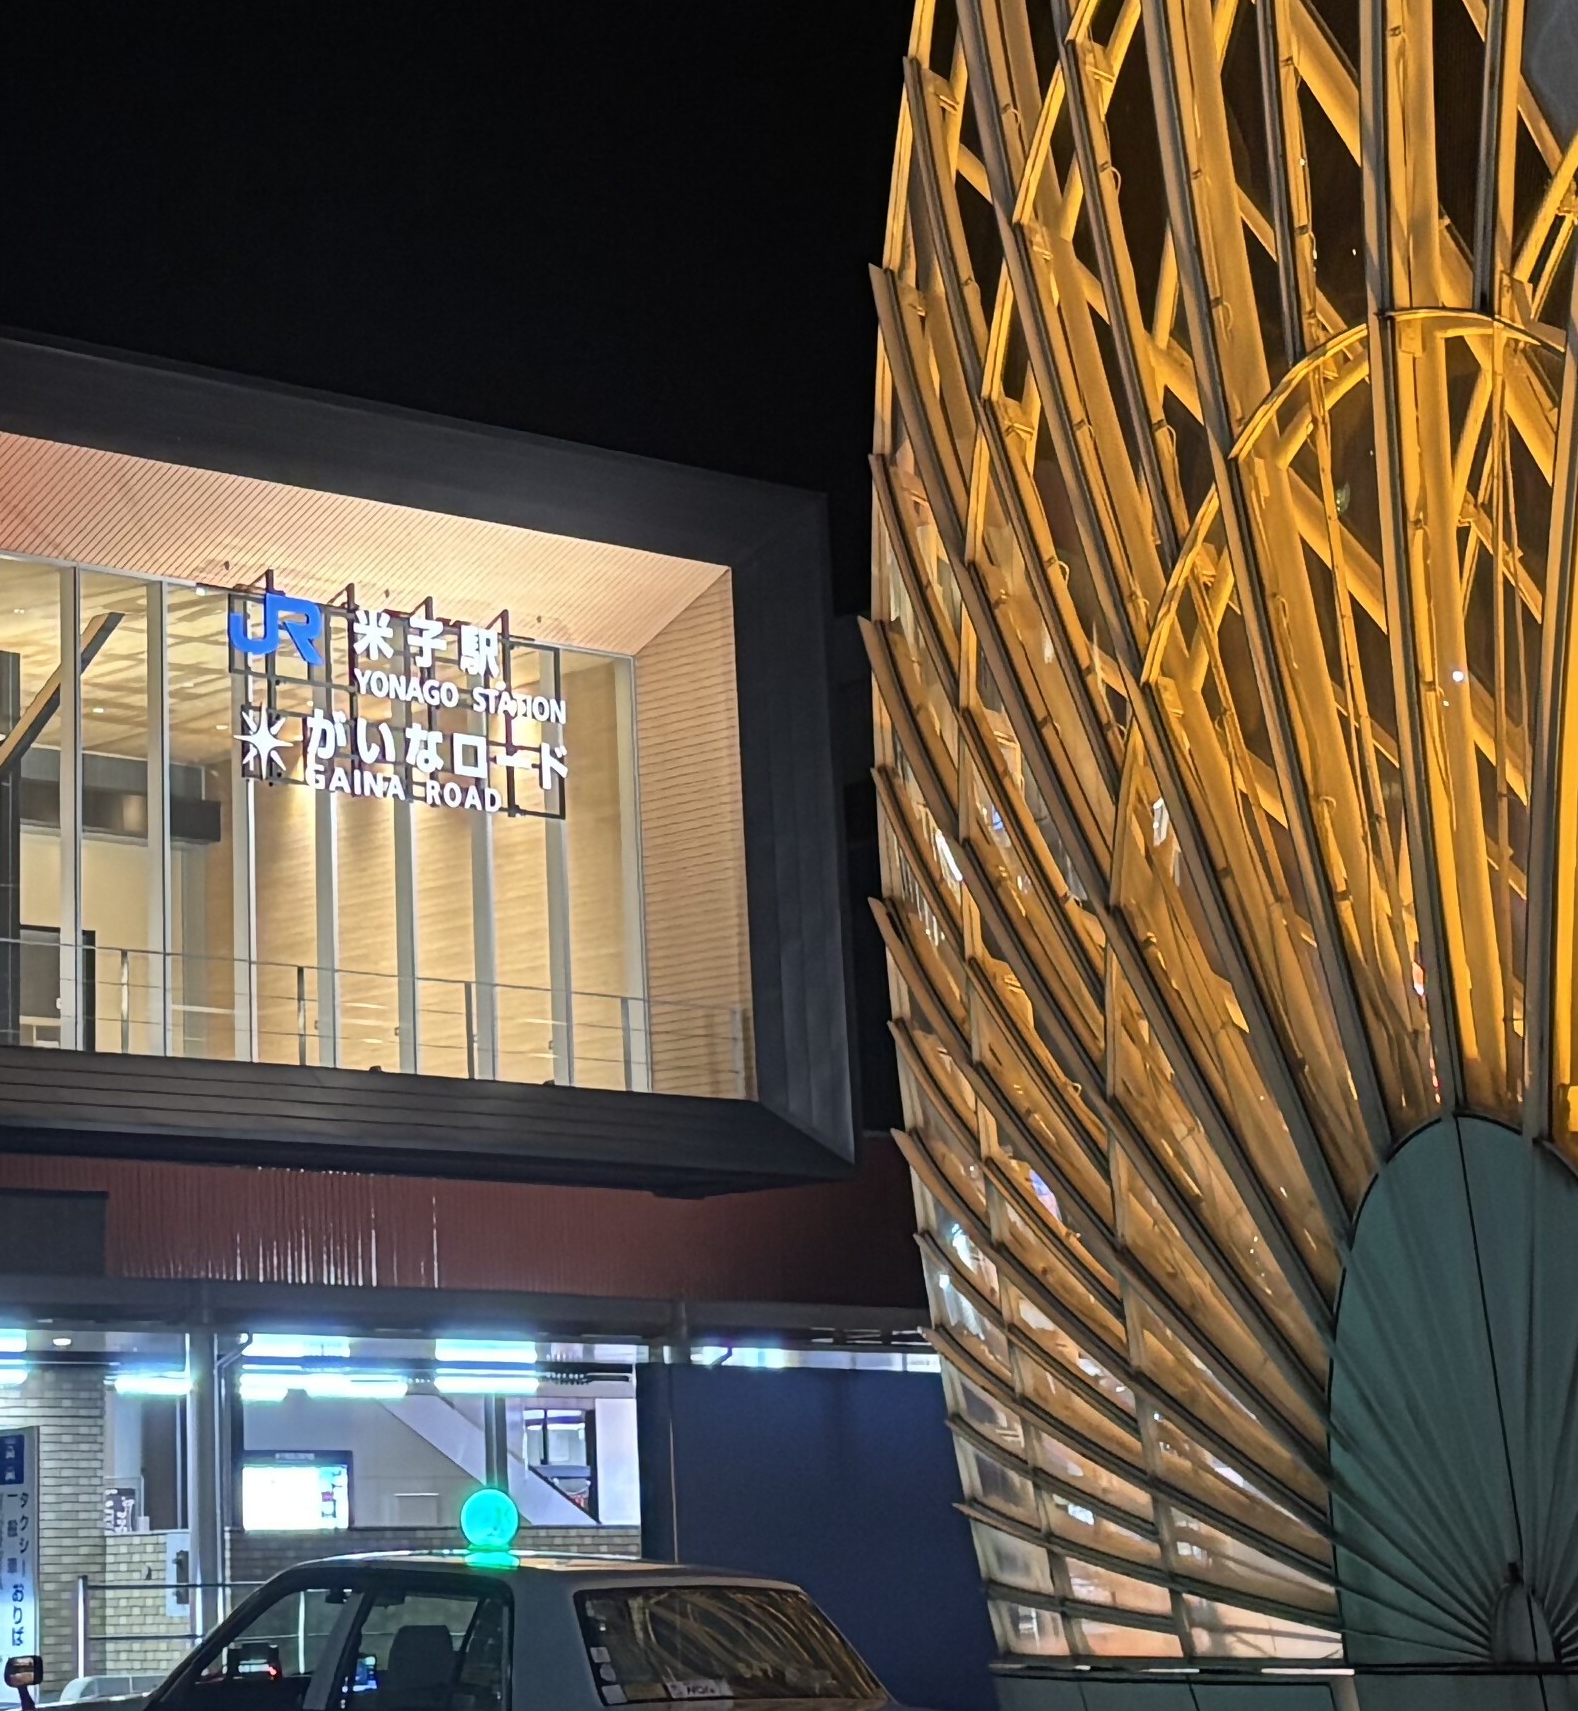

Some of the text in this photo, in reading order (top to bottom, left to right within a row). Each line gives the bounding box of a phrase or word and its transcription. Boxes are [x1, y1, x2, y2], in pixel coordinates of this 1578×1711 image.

[228, 592, 322, 665] JR
[353, 610, 499, 677] 米子駅
[354, 668, 566, 724] YONAGO STATION
[306, 709, 568, 790] がいなロード
[305, 765, 502, 812] GAINA ROAD
[19, 1492, 30, 1578] タクシー
